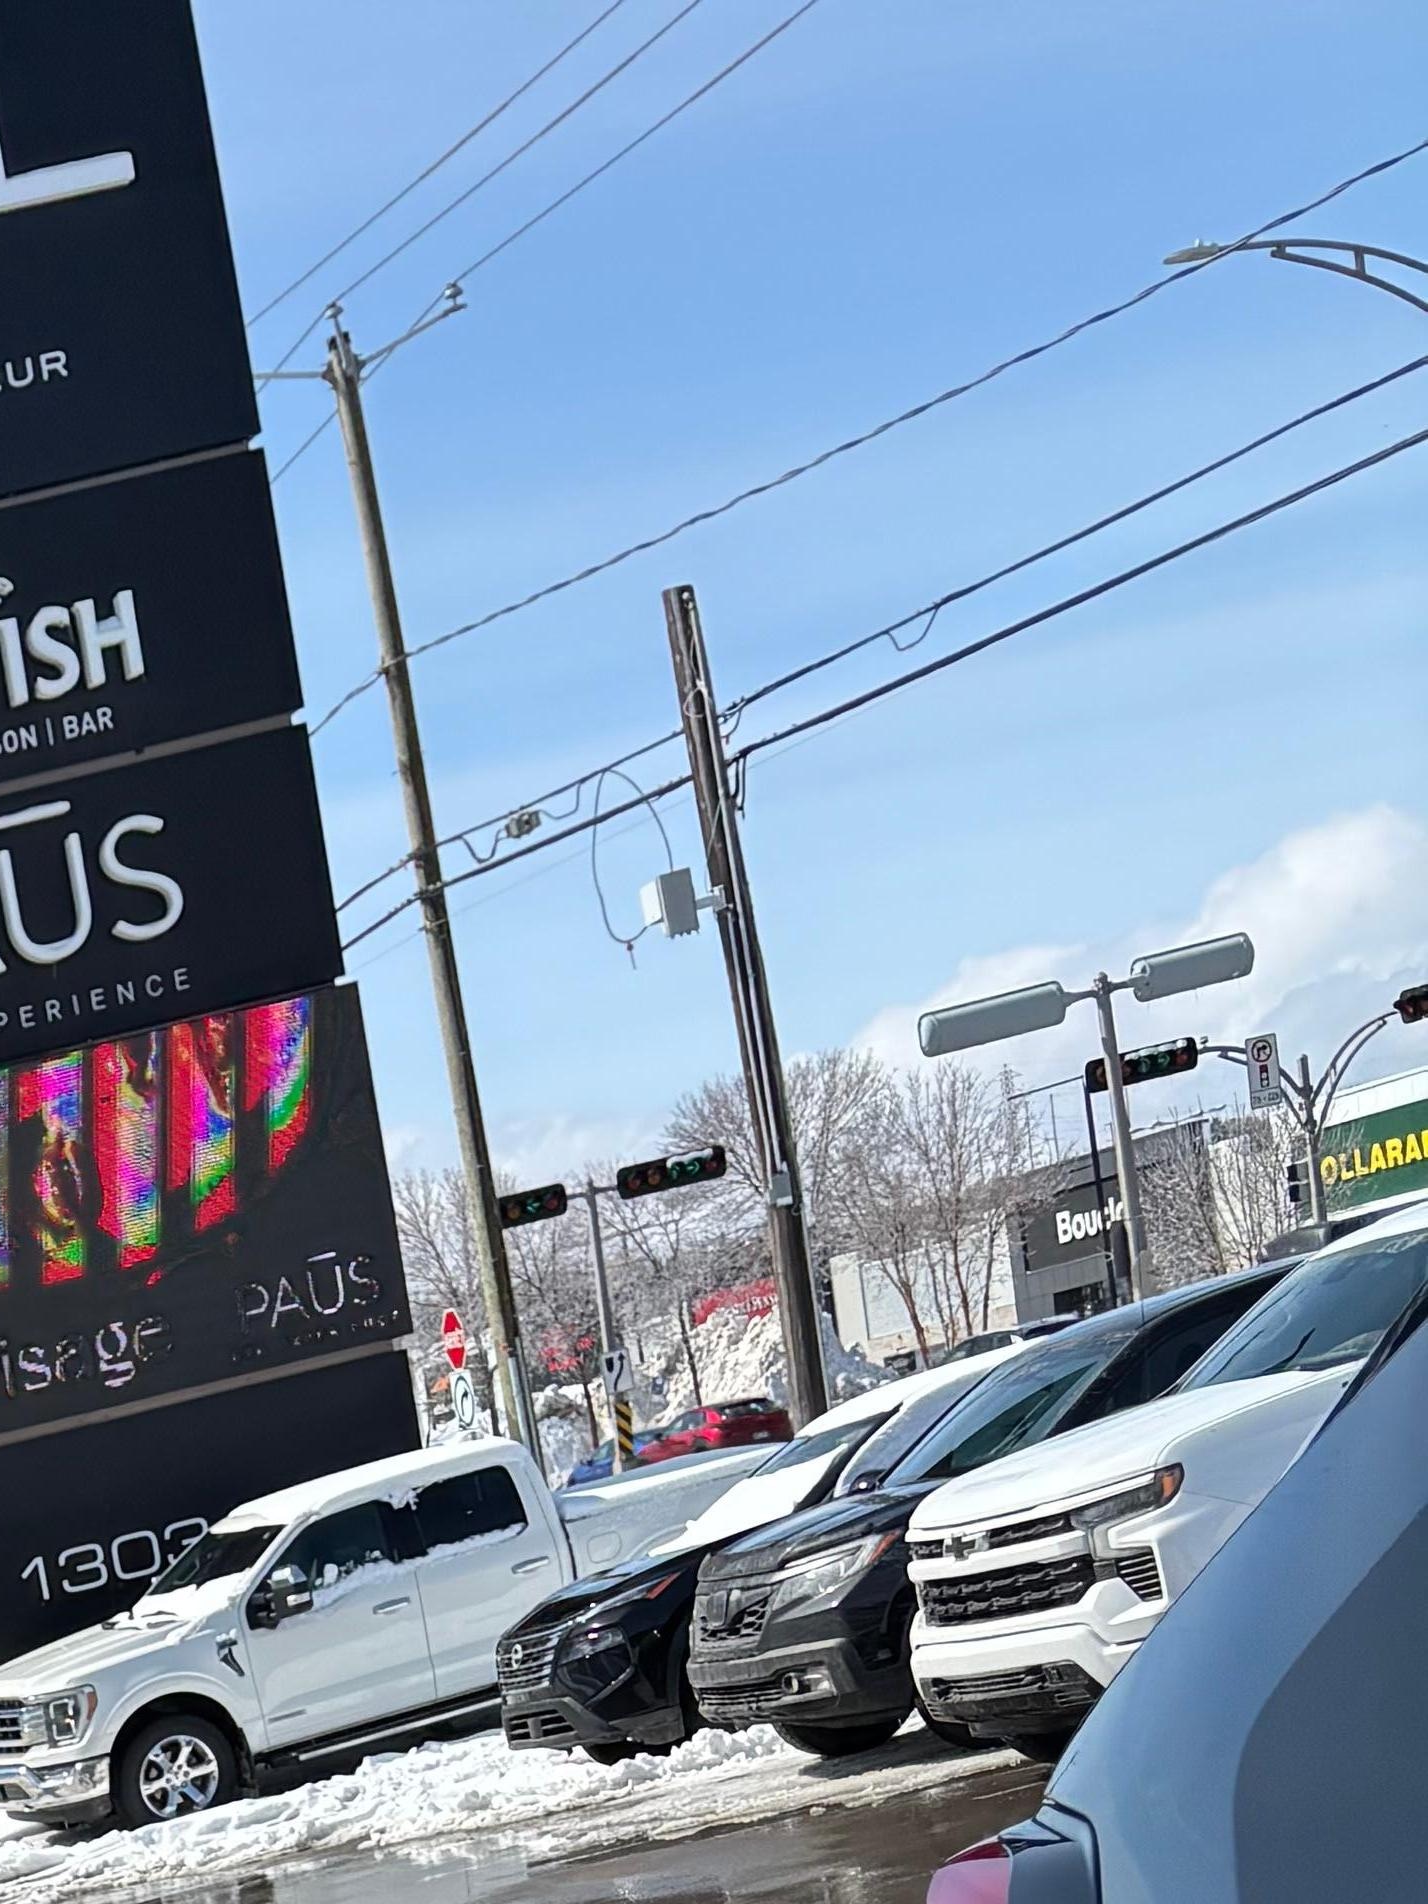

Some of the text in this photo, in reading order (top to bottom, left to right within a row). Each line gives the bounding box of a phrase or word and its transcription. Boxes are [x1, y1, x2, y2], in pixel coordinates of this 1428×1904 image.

[63, 707, 115, 741] BAR
[1320, 1130, 1428, 1186] OLLARA
[21, 1517, 209, 1601] 1303
